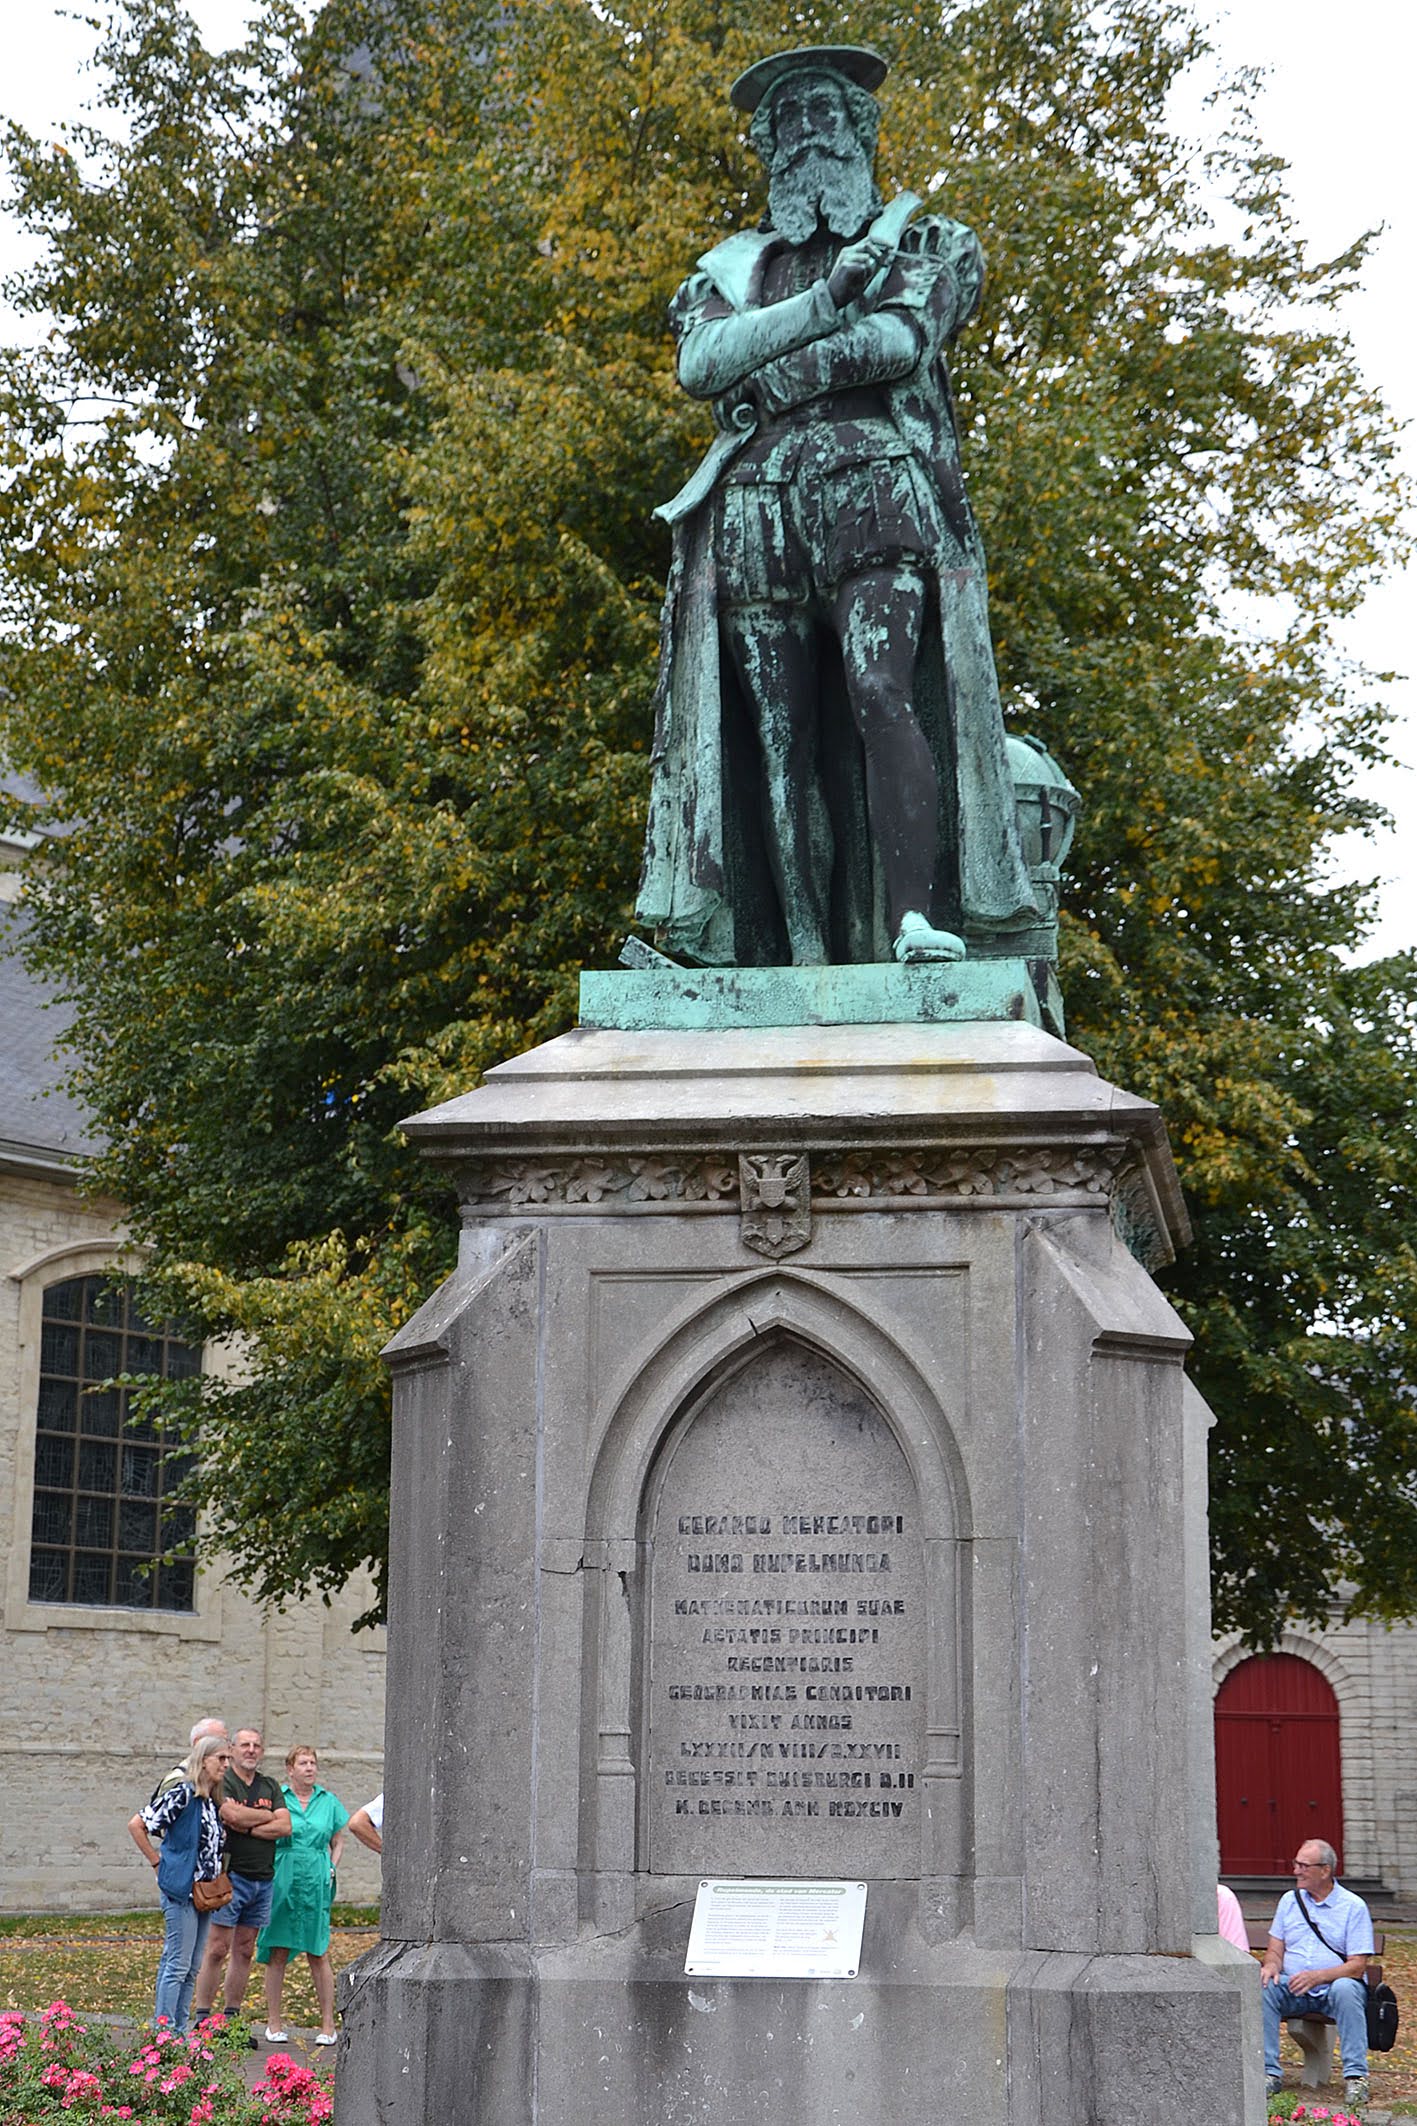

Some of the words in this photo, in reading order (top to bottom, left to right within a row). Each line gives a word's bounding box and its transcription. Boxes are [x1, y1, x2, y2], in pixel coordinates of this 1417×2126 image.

[782, 1515, 904, 1535] MERCATORI
[856, 1600, 905, 1616] SUAE
[702, 1628, 782, 1644] AETATIS
[788, 1628, 879, 1644] PRINCIPI
[668, 1684, 798, 1701] GEOGRAPHIAE
[805, 1685, 912, 1701] CONDITORI
[728, 1714, 782, 1730] VIXIT
[790, 1714, 853, 1730] ANNOS
